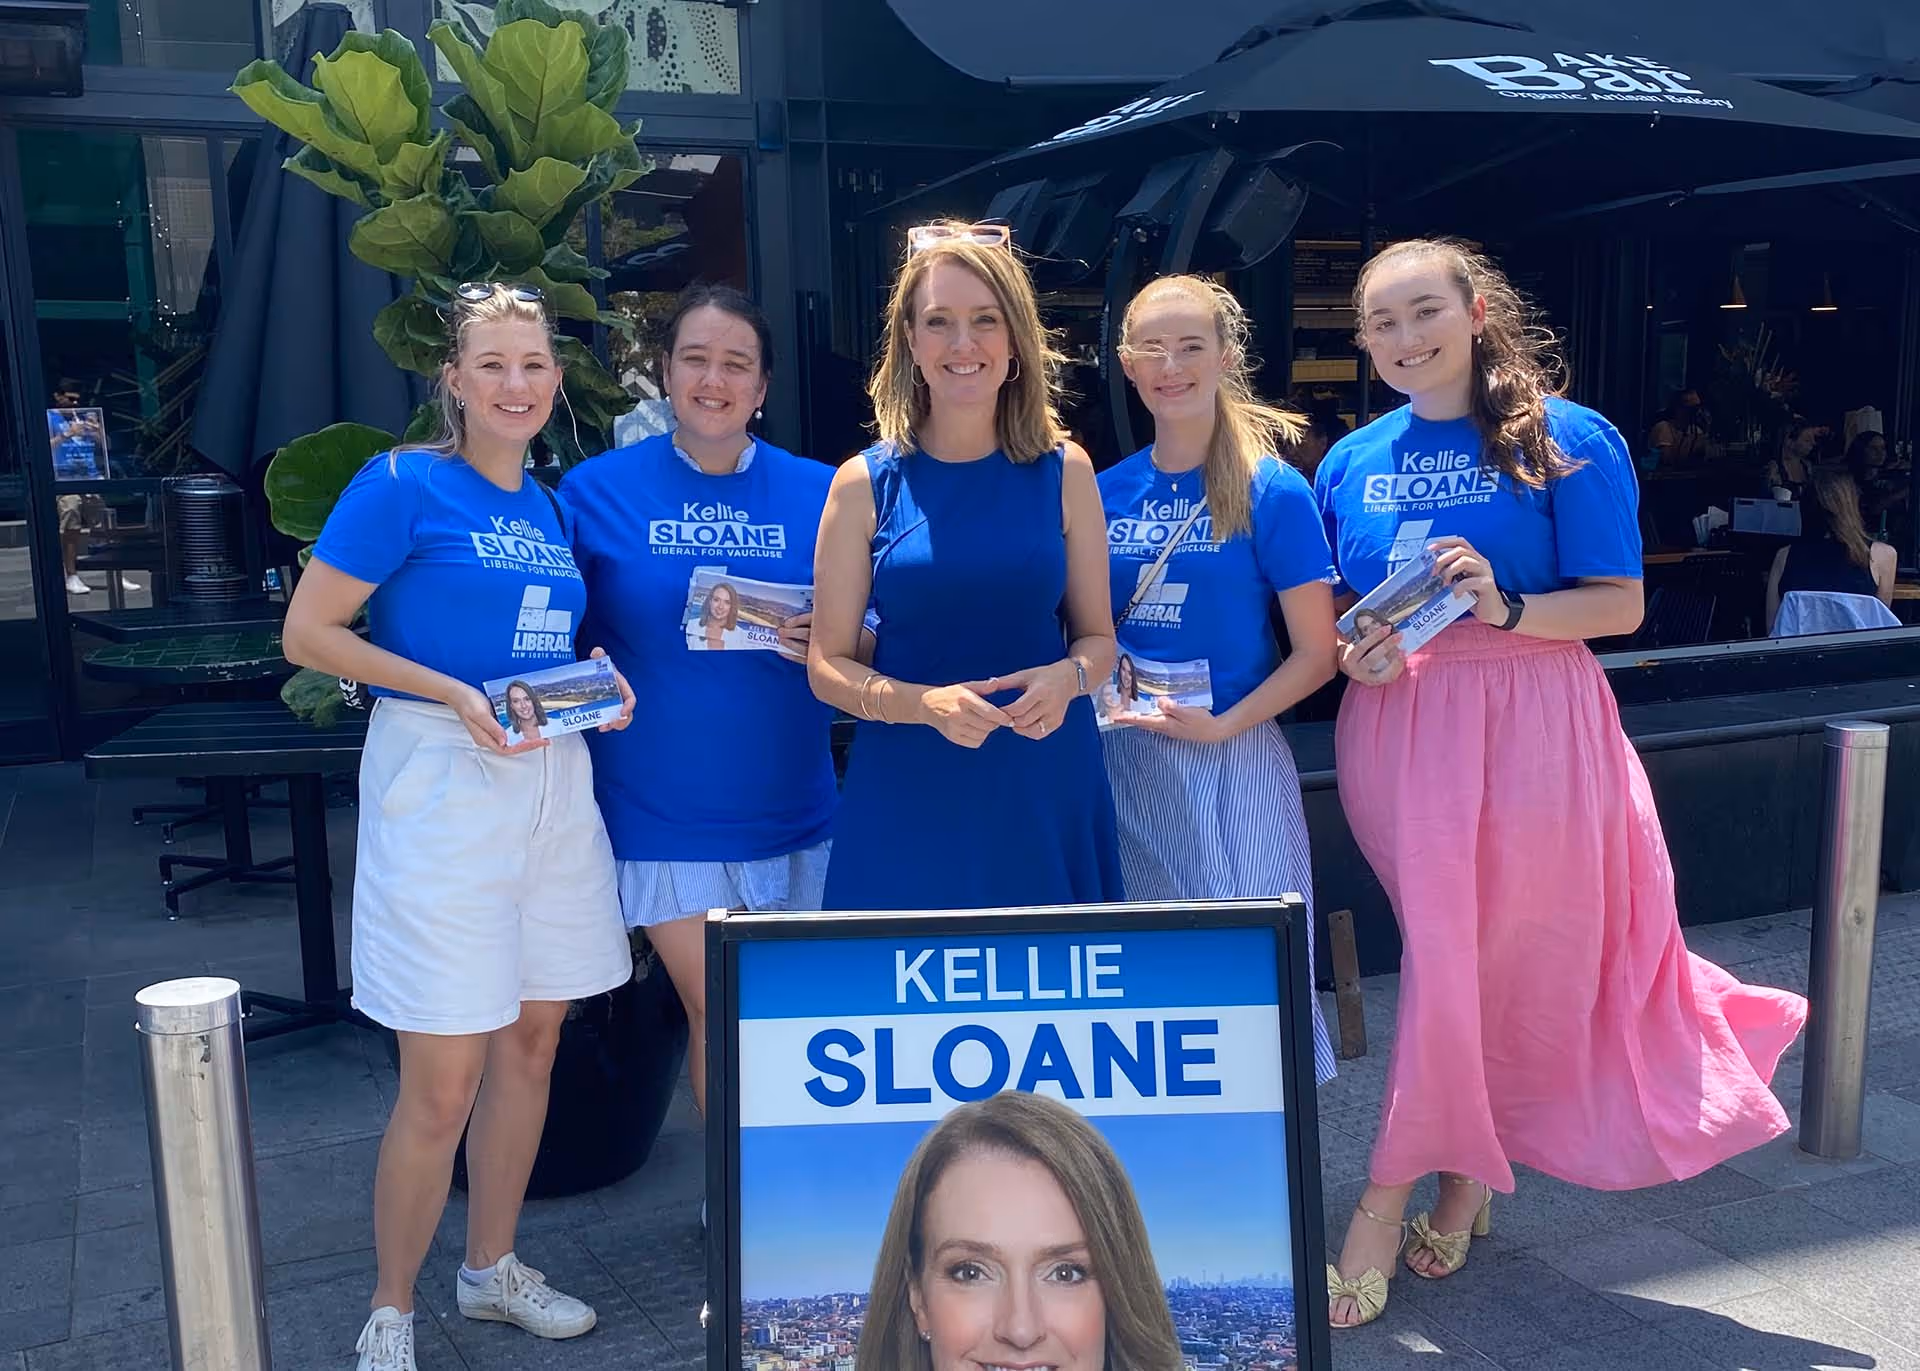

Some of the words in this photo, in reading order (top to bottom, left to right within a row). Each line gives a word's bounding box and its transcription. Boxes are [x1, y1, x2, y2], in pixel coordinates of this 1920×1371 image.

[1498, 90, 1587, 100] Organic
[1591, 92, 1662, 102] Artisan
[1663, 94, 1735, 109] Bakery
[1402, 450, 1470, 472] Kellie
[1369, 468, 1493, 501] SLOANE
[684, 502, 749, 522] Kellie
[1364, 503, 1408, 513] LIBERAL
[1412, 502, 1433, 511] FOR
[1437, 494, 1491, 509] VAUCLUSE
[490, 516, 545, 542] Kellie
[655, 523, 781, 547] SLOANE
[652, 547, 697, 556] LIBERAL
[701, 548, 723, 556] FOR
[727, 549, 782, 558] VAUCLUSE
[1110, 546, 1145, 555] IBERAL
[483, 559, 525, 573] LIBERAL
[528, 566, 545, 575] FOR
[1128, 604, 1182, 622] LIBERAL
[1413, 601, 1447, 631] SLOANE
[513, 631, 571, 652] LIBERAL
[747, 632, 779, 645] SLOAN
[562, 711, 602, 727] SLOANE
[895, 944, 1124, 1003] KELLIE
[804, 1019, 1222, 1107] SLOANE
